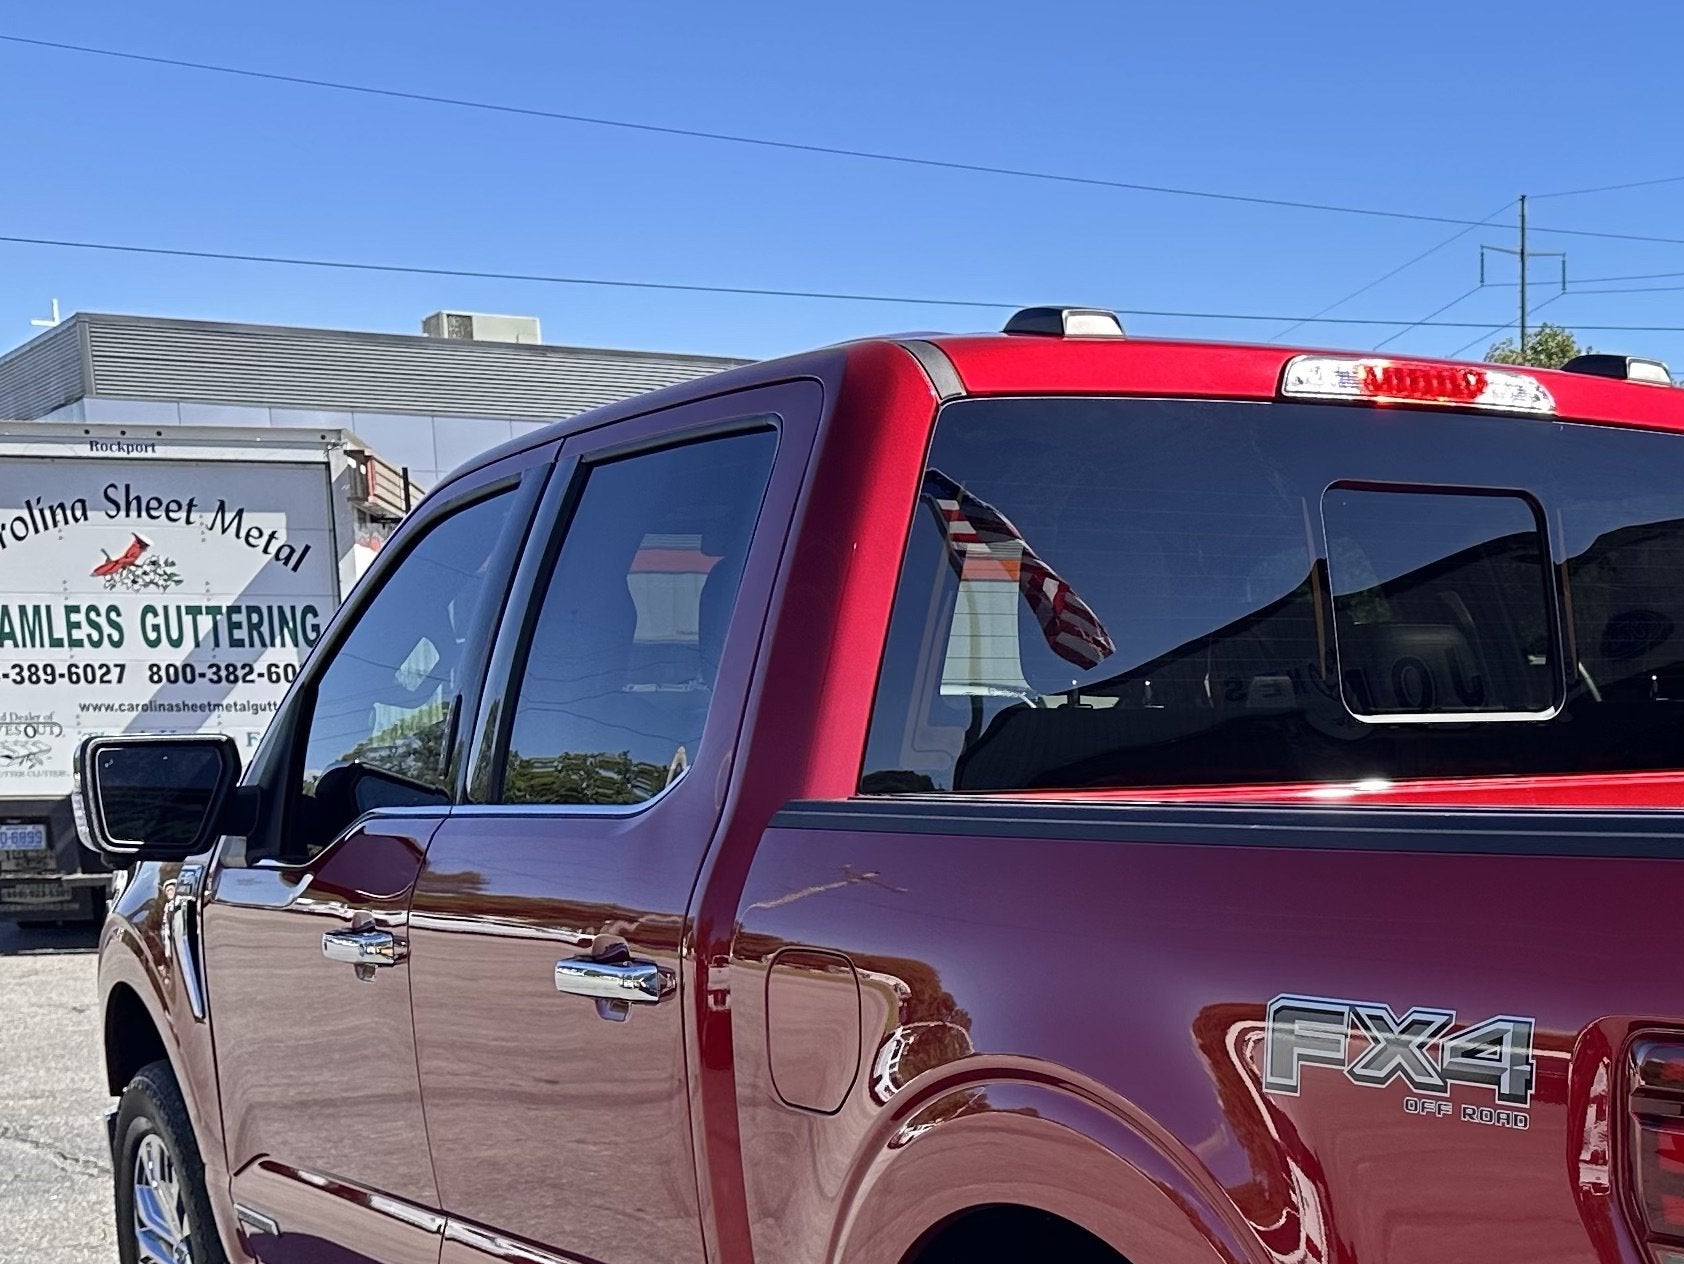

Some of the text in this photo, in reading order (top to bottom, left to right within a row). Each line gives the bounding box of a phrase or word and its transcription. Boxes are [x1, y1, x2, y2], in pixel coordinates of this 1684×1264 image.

[89, 439, 156, 455] Rockport
[0, 483, 312, 573] rolina Sheet Metal
[0, 604, 321, 649] AMLESS GUTTERING
[149, 663, 303, 684] 800-382-60
[1263, 993, 1535, 1107] FX4
[1403, 1097, 1530, 1130] OFF ROAD
